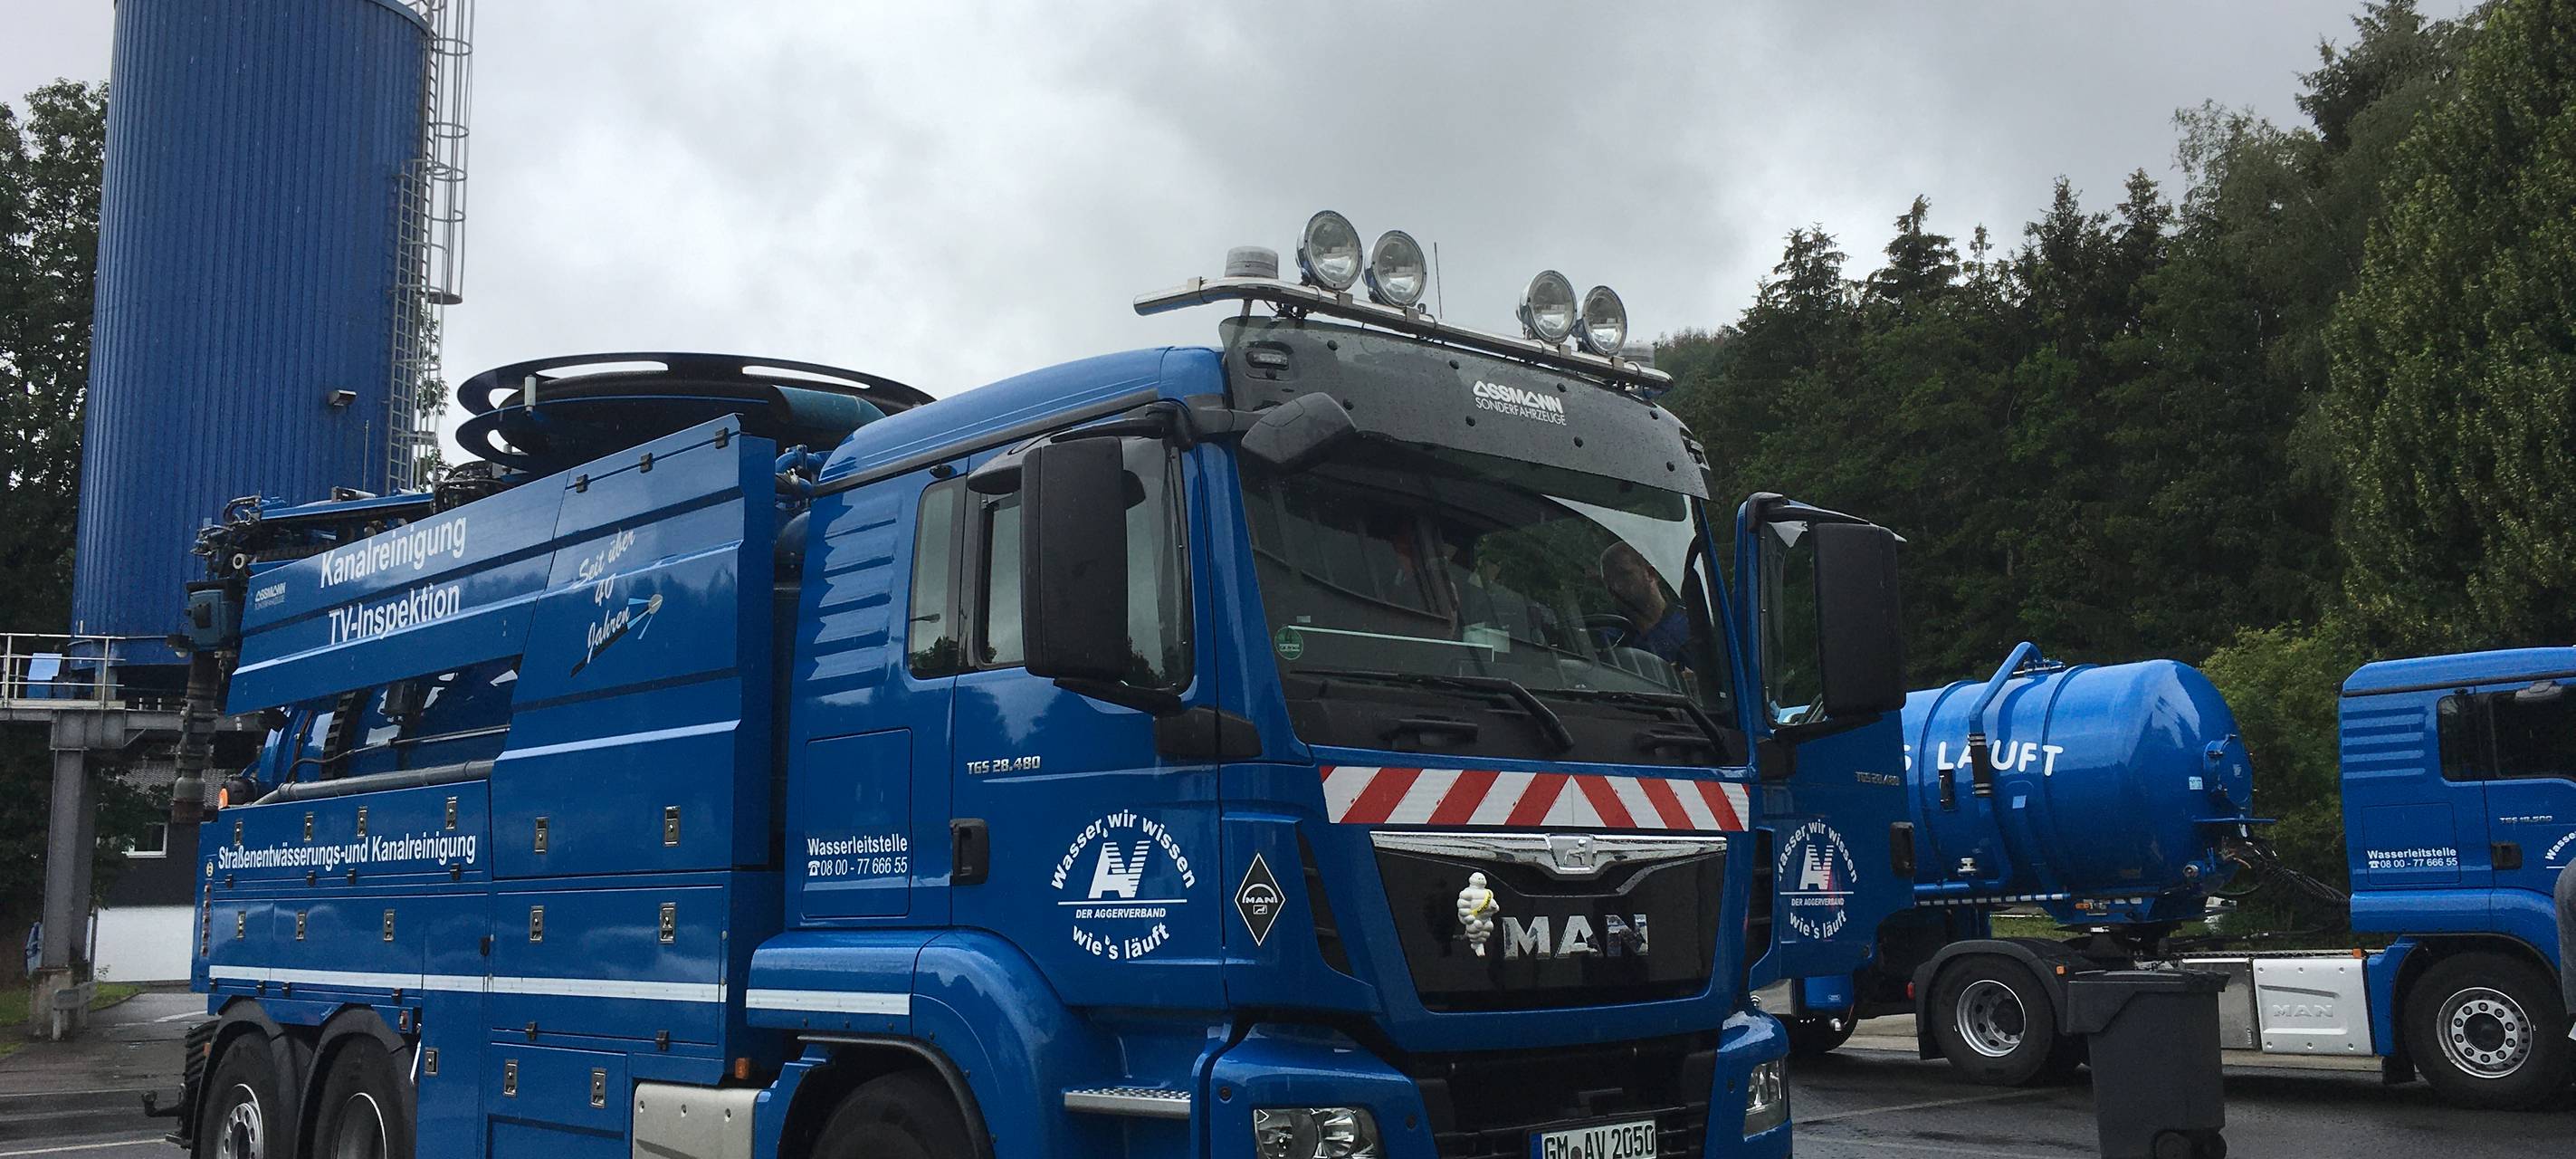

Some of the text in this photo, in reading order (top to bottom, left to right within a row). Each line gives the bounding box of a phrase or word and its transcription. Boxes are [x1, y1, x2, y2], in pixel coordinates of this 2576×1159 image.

[1473, 380, 1563, 414] ASSMANN
[1475, 397, 1567, 426] SONDERFAHRZEUGE
[320, 516, 466, 588] Kanalreinigung
[579, 527, 635, 582] Seit über
[595, 573, 615, 607] 40
[328, 582, 460, 645] TV-Inspektion
[587, 606, 631, 664] Jahren
[967, 755, 1041, 775] TGS 28.480
[372, 830, 476, 865] Kanalreinigung
[807, 833, 908, 857] Wasserleitstelle
[1107, 809, 1138, 828] wir
[1142, 817, 1196, 889] wissen
[1808, 819, 1827, 835] wir
[1828, 827, 1857, 884] wissen
[2367, 847, 2457, 859] Wasserleitstelle
[2544, 830, 2576, 860] Wasse
[820, 859, 833, 876] 08
[835, 858, 848, 876] 00
[857, 857, 870, 875] 77
[872, 857, 892, 875] 666
[893, 857, 908, 874] 55
[2380, 859, 2391, 868] 08
[2393, 858, 2405, 868] 00
[2412, 858, 2424, 867] 77
[2426, 857, 2444, 867] 666
[2446, 857, 2458, 867] 55
[1075, 907, 1166, 919] DER AGGERVERBAND
[1791, 897, 1803, 906] DER
[1501, 914, 1649, 961] MAN
[1822, 909, 1846, 938] läuft
[1125, 922, 1170, 960] läuft
[2273, 1004, 2333, 1018] MAN
[1544, 1125, 1655, 1159] GM AV 2050
